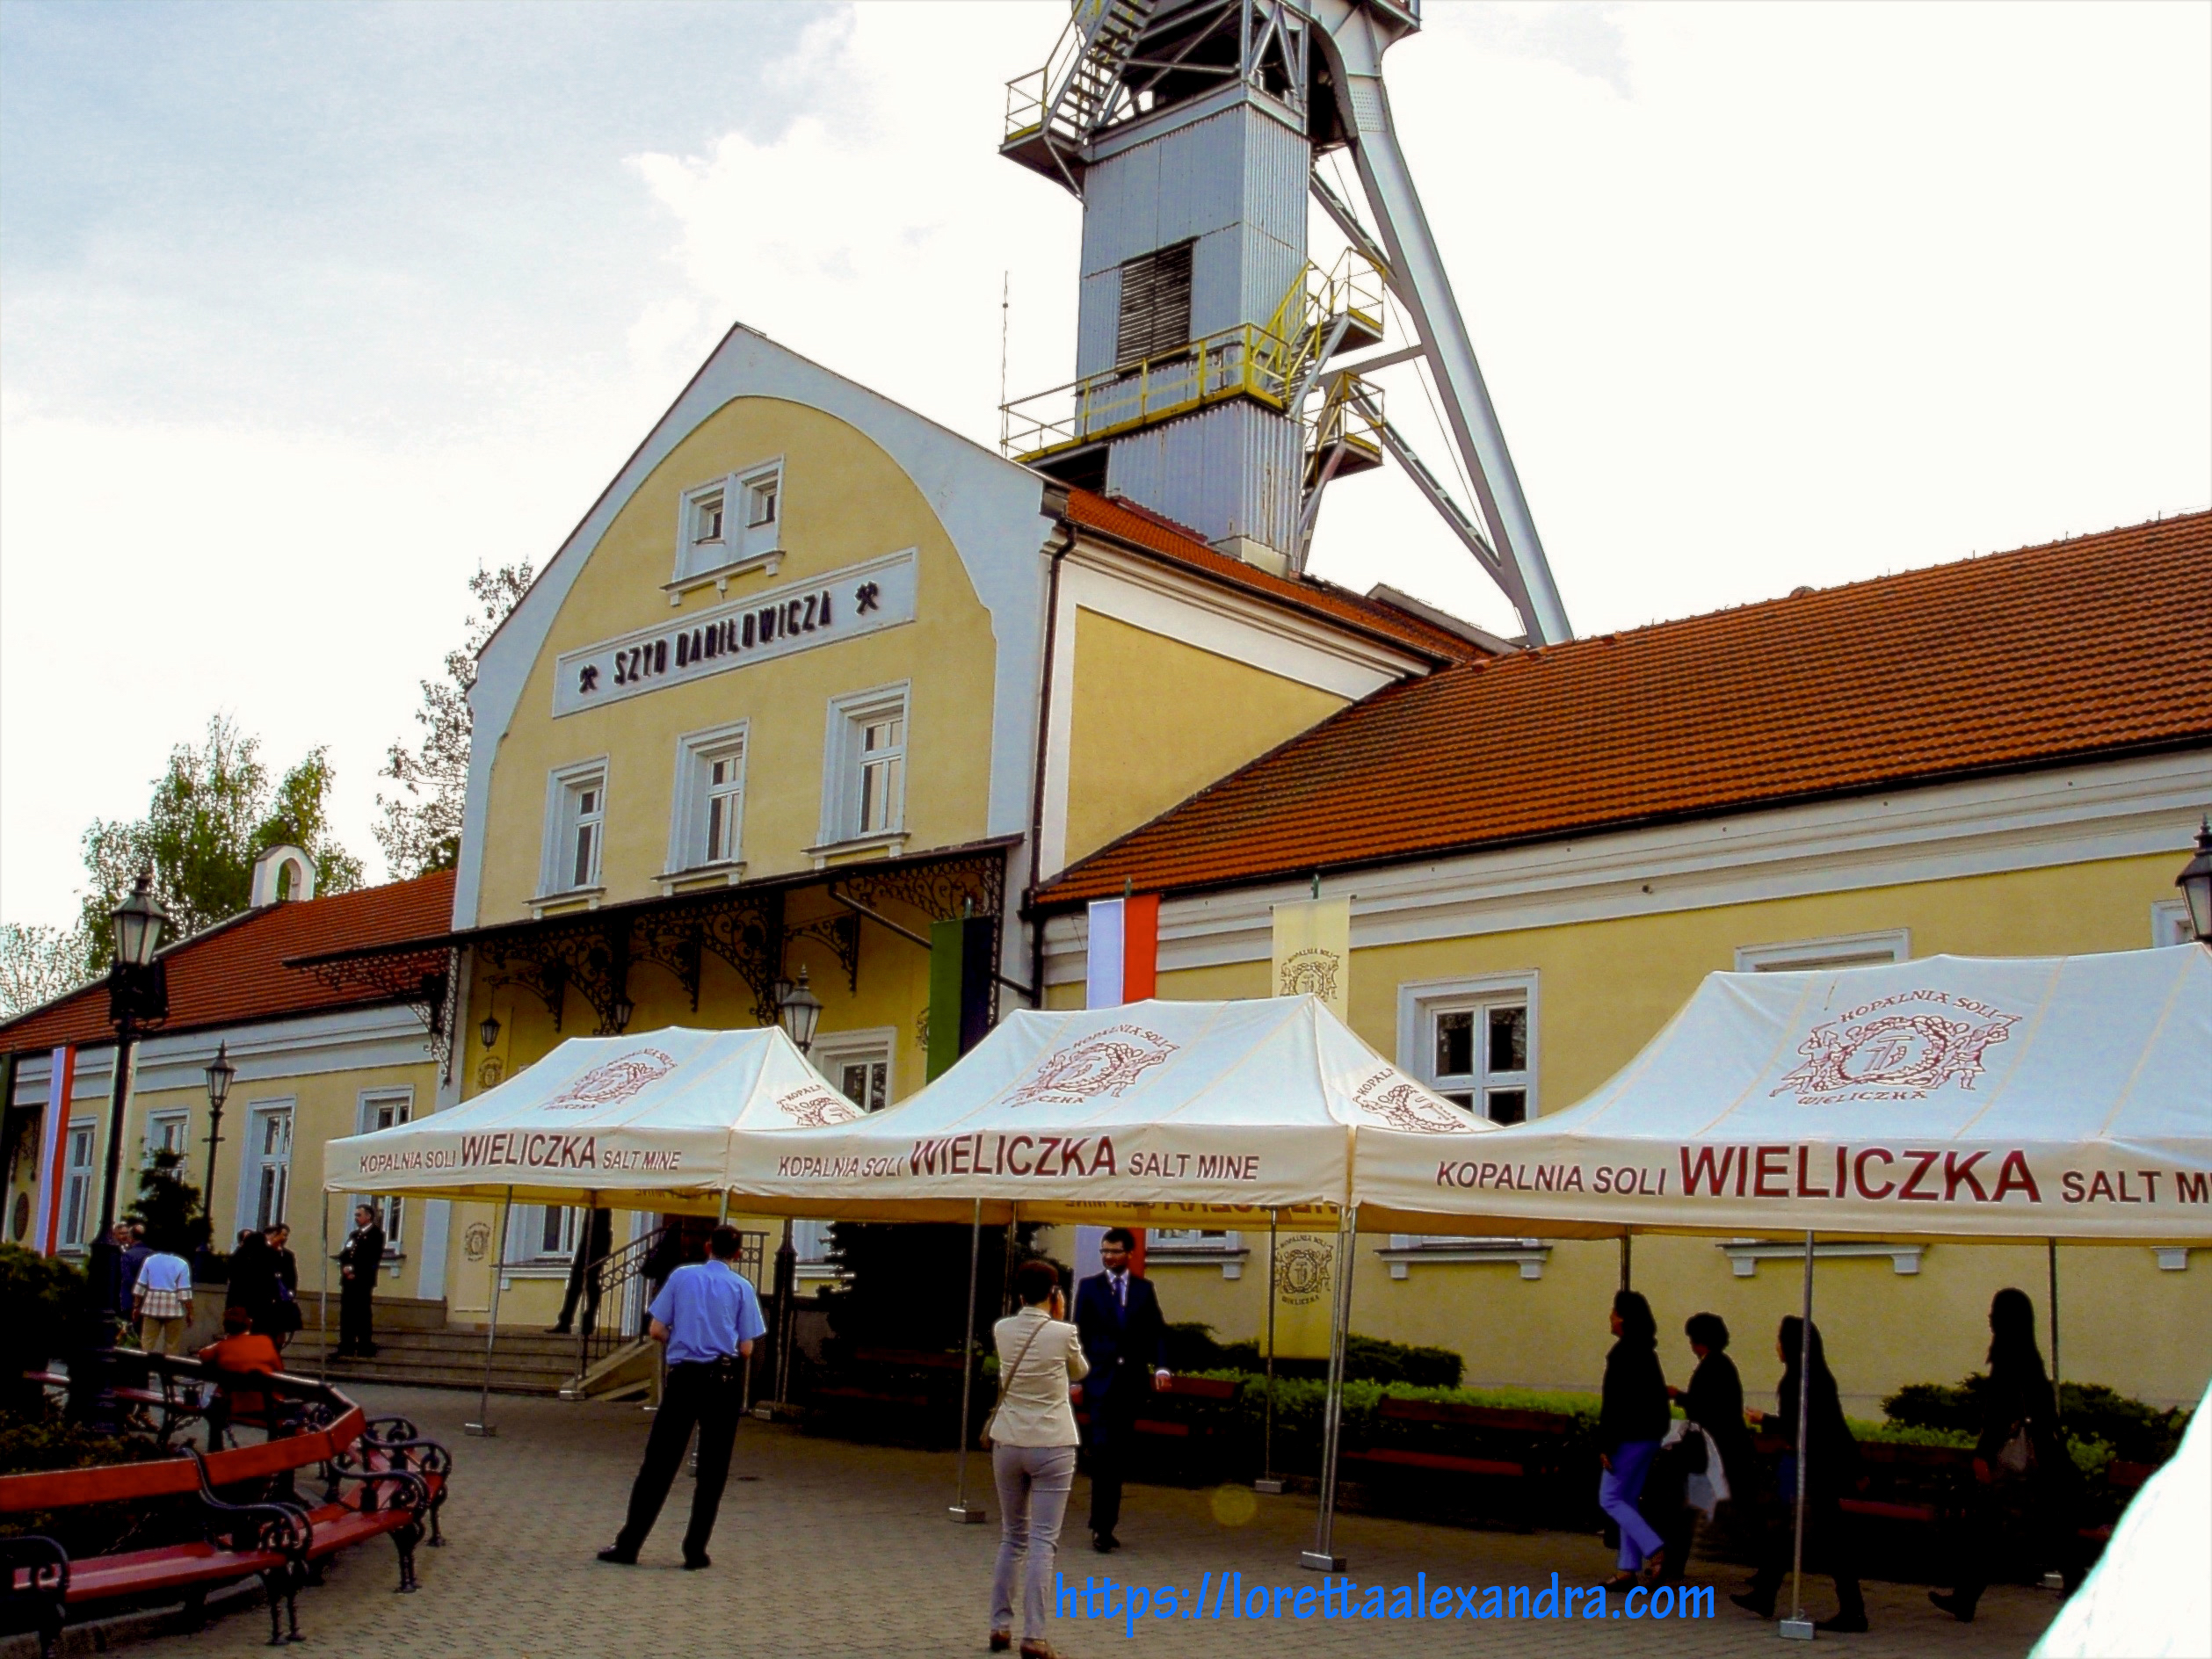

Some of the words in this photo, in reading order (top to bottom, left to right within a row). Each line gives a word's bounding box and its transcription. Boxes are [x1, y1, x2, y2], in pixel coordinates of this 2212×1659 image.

[613, 639, 667, 685] SZYB
[674, 590, 831, 668] DANIŁOWICZA
[1953, 996, 1998, 1019] SOLI
[359, 1151, 423, 1173] KOPALNIA
[425, 1149, 456, 1169] SOLI
[461, 1133, 596, 1169] WIELICZKA
[602, 1150, 641, 1170] SALT
[642, 1151, 682, 1170] MINE
[778, 1156, 859, 1177] KOPALNIA
[861, 1156, 904, 1177] SOLI
[909, 1134, 1117, 1177] WIELICZKA
[1128, 1152, 1191, 1178] SALT
[1196, 1154, 1260, 1180] MINE
[1436, 1160, 1585, 1193] KOPALNIA
[1592, 1166, 1667, 1196] SOLI
[1679, 1145, 2042, 1203] WIELICZKA
[2061, 1170, 2162, 1204] SALT
[2174, 1170, 2212, 1205] M
